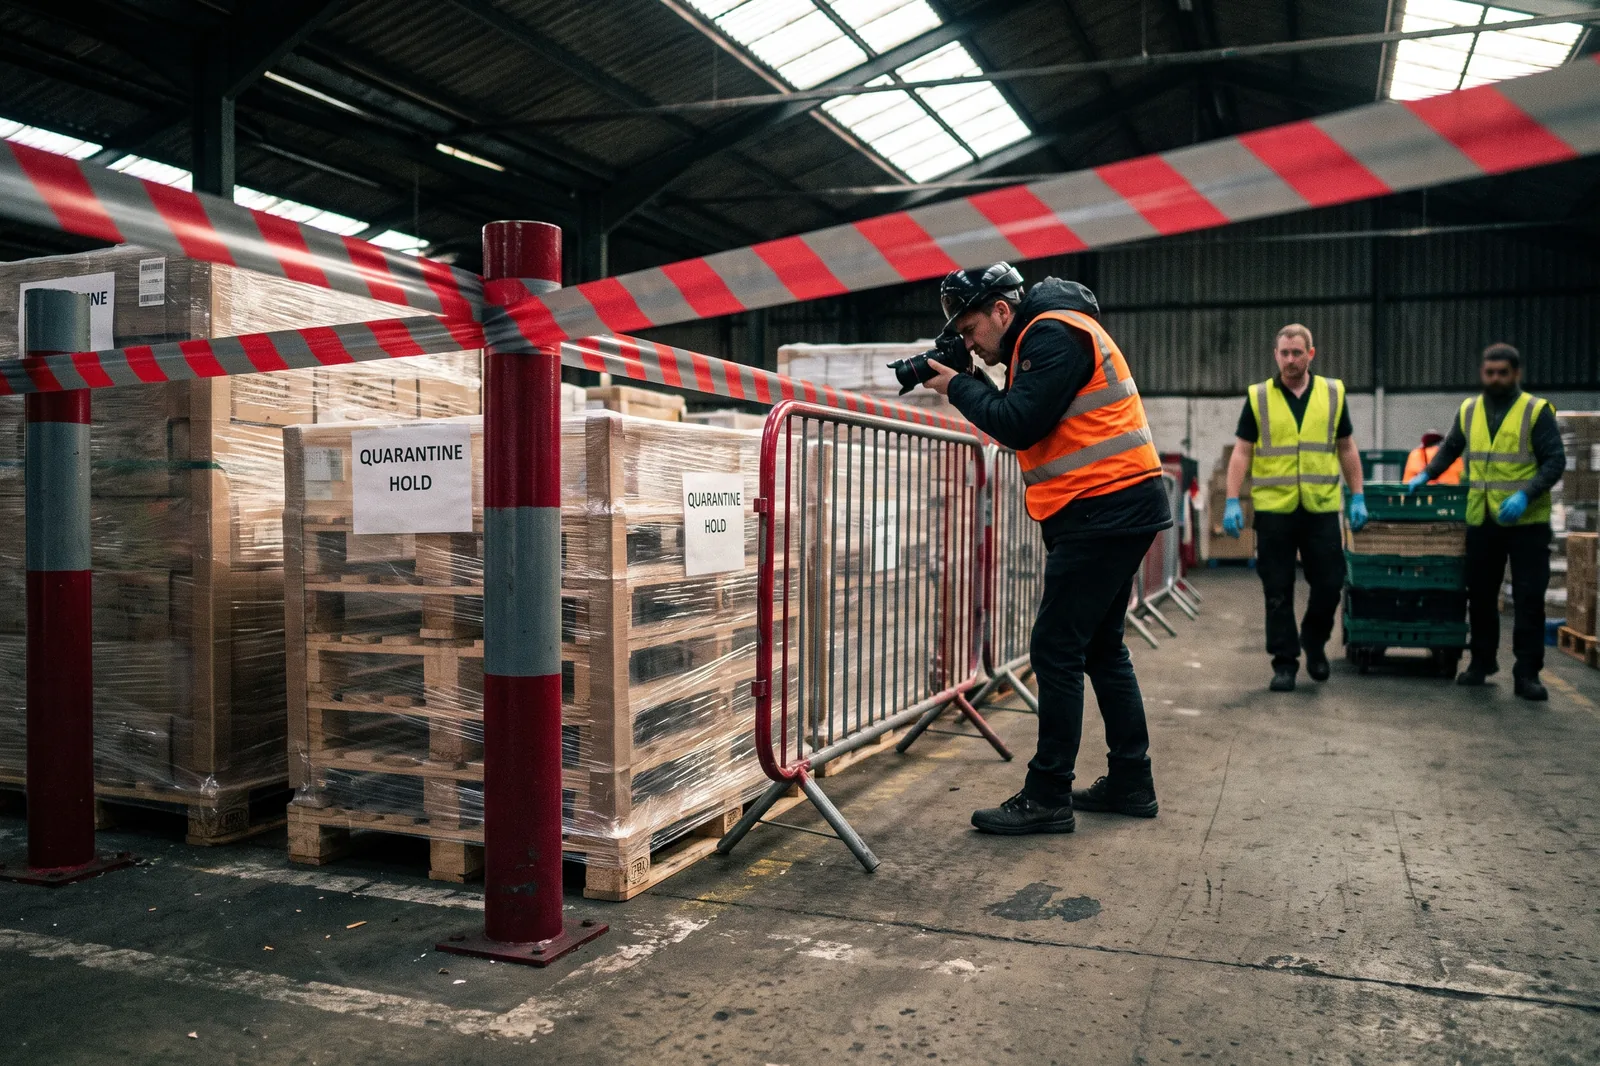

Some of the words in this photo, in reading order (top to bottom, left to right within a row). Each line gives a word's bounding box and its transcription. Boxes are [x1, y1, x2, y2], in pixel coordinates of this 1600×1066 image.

[360, 445, 463, 466] QUARANTINE
[389, 475, 432, 492] HOLD
[688, 492, 741, 509] QUARANTINE
[704, 518, 727, 534] HOLD
